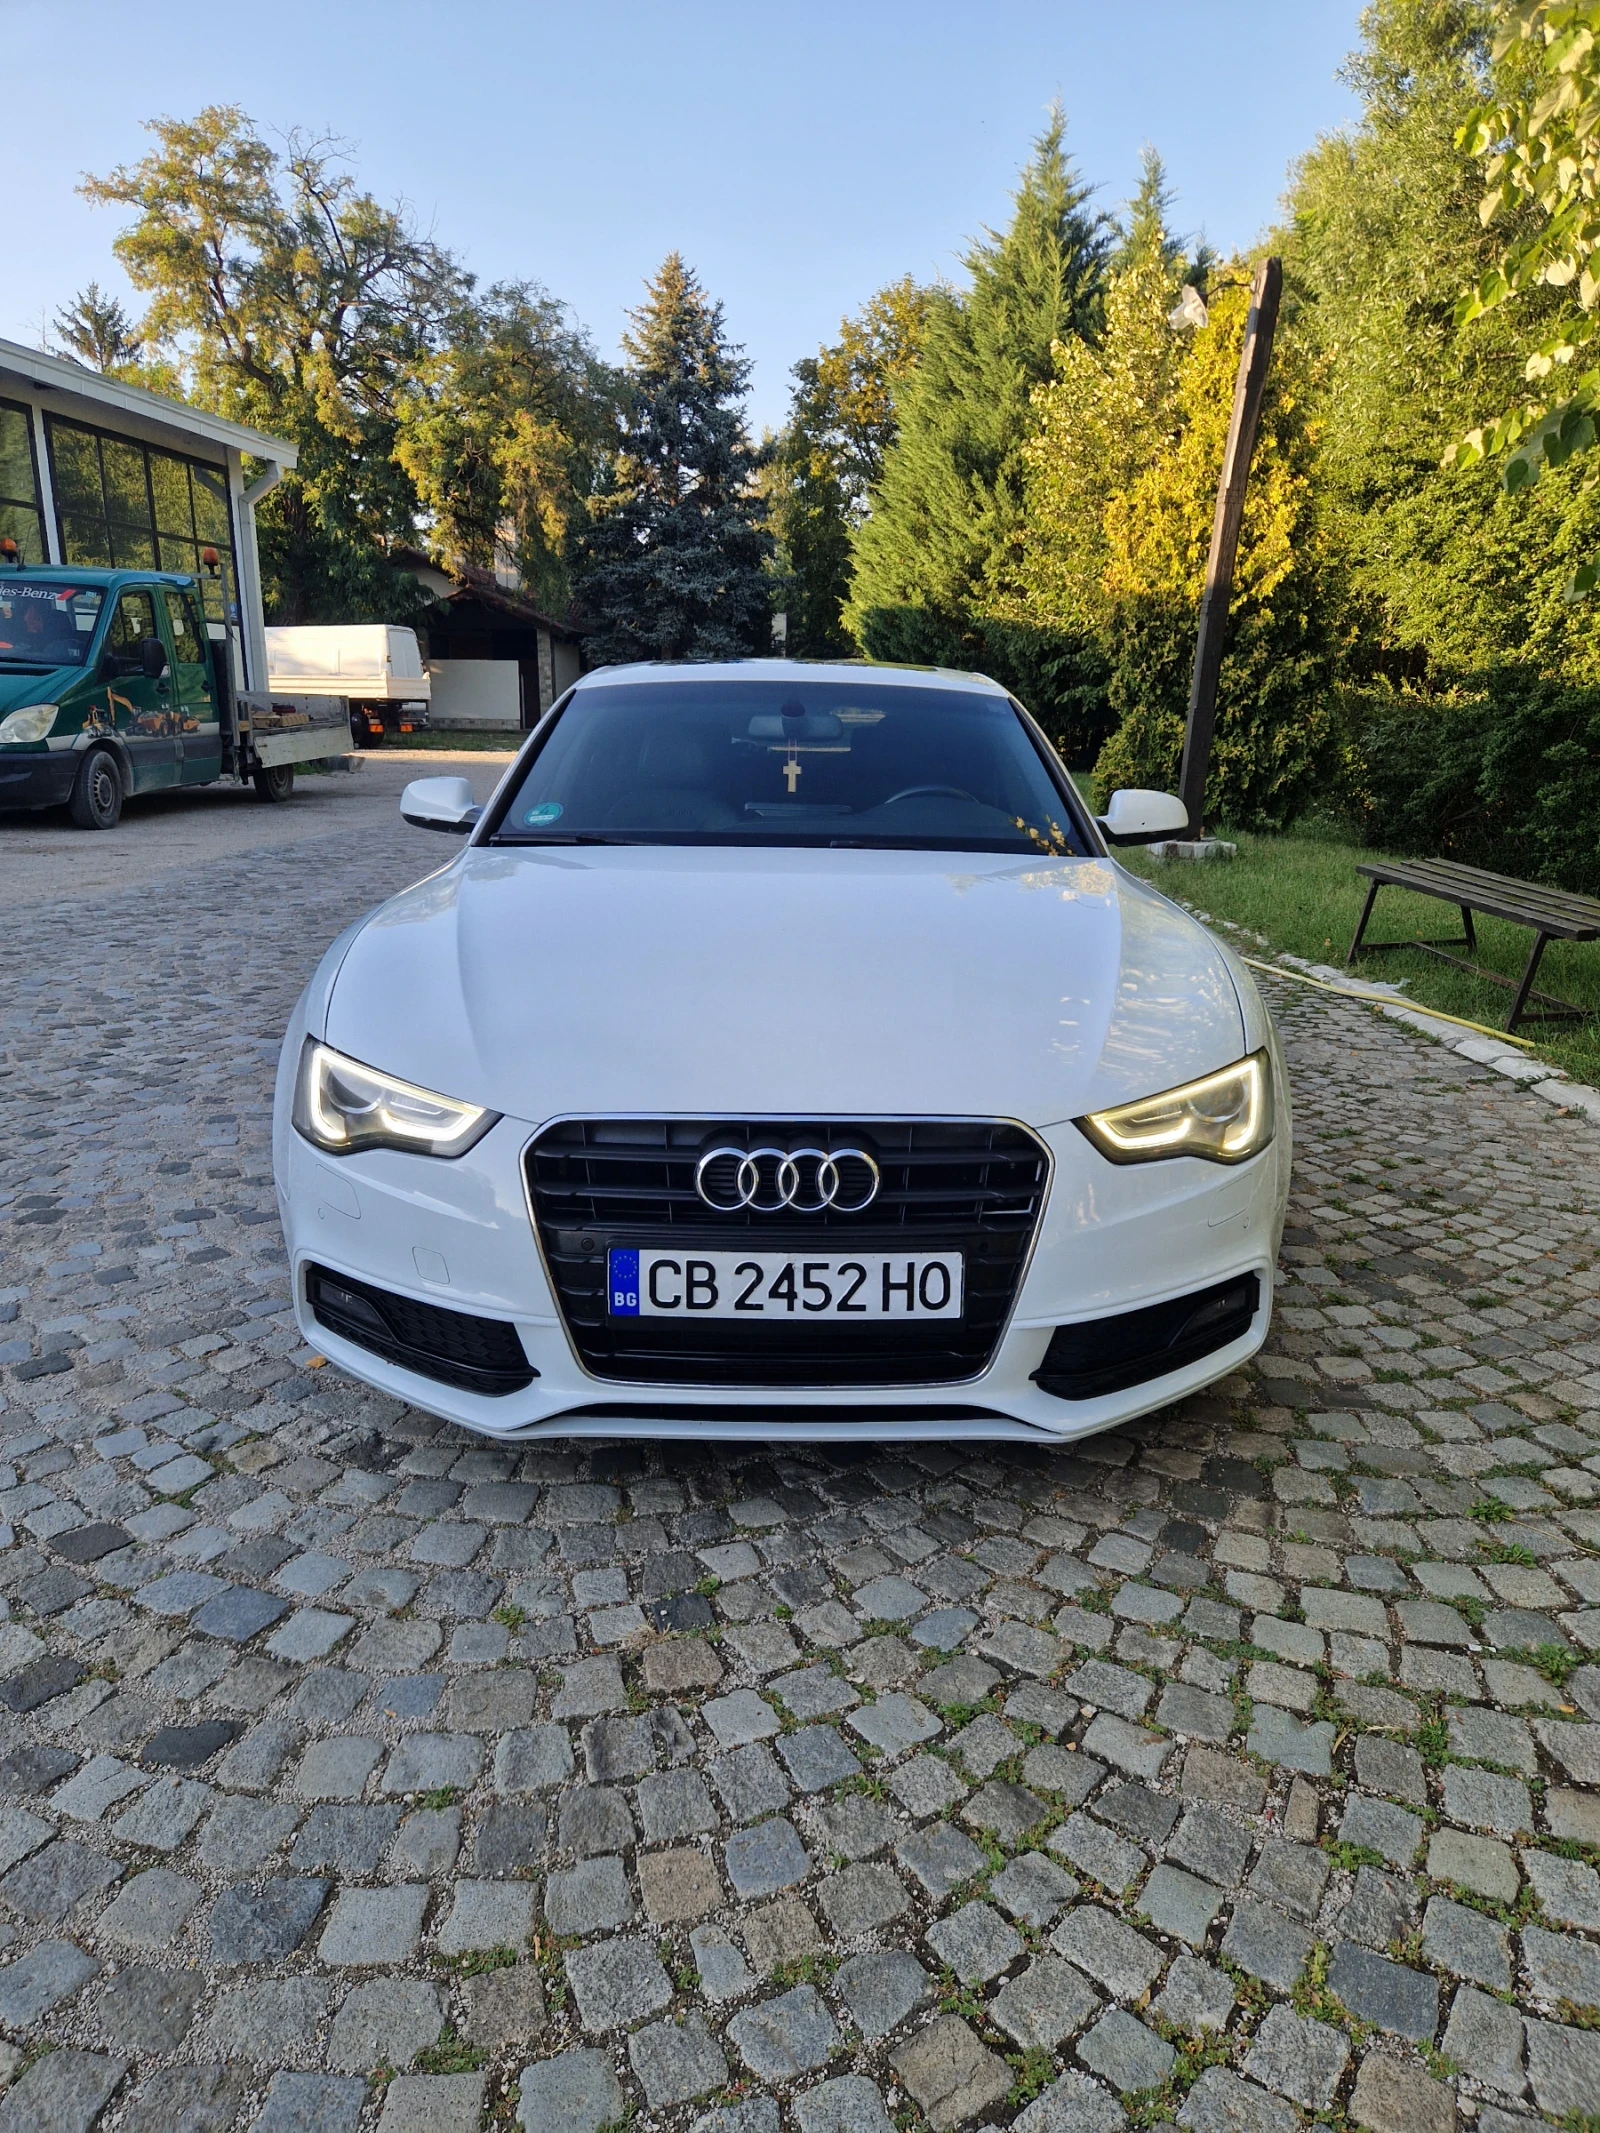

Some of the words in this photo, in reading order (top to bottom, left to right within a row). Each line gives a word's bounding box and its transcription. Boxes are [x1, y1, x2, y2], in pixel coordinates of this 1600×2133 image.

[614, 1292, 637, 1307] BG
[649, 1259, 718, 1310] CB
[734, 1260, 867, 1312] 2452
